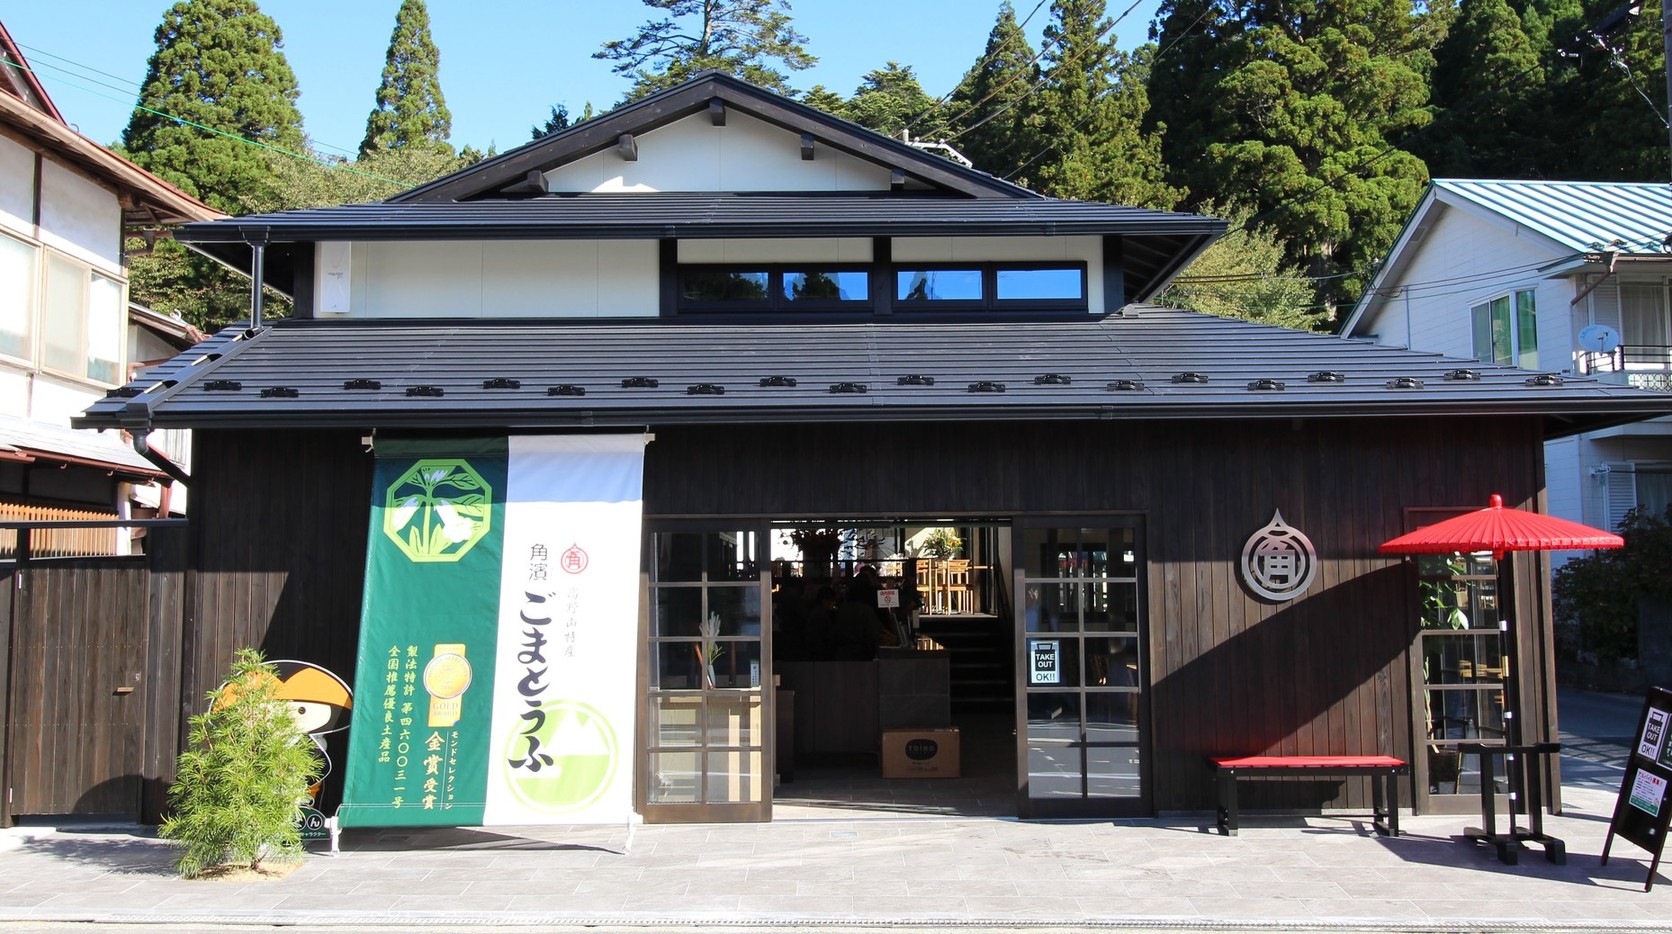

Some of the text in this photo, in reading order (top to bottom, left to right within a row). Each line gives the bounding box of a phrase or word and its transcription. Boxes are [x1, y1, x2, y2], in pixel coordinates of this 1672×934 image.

[507, 543, 556, 773] 角濱 ごまとうふ
[1035, 653, 1055, 661] TAKE
[403, 645, 418, 697] 製法特許
[1035, 673, 1056, 682] OK!!
[378, 645, 401, 763] 全国推薦優良土産品
[433, 702, 459, 710] GOLD
[1647, 722, 1661, 734] TAKE
[1646, 731, 1658, 742] OUT
[1641, 743, 1656, 757] OK!!
[422, 731, 446, 810] 金賞受賞
[445, 731, 459, 810] モンドセレクション
